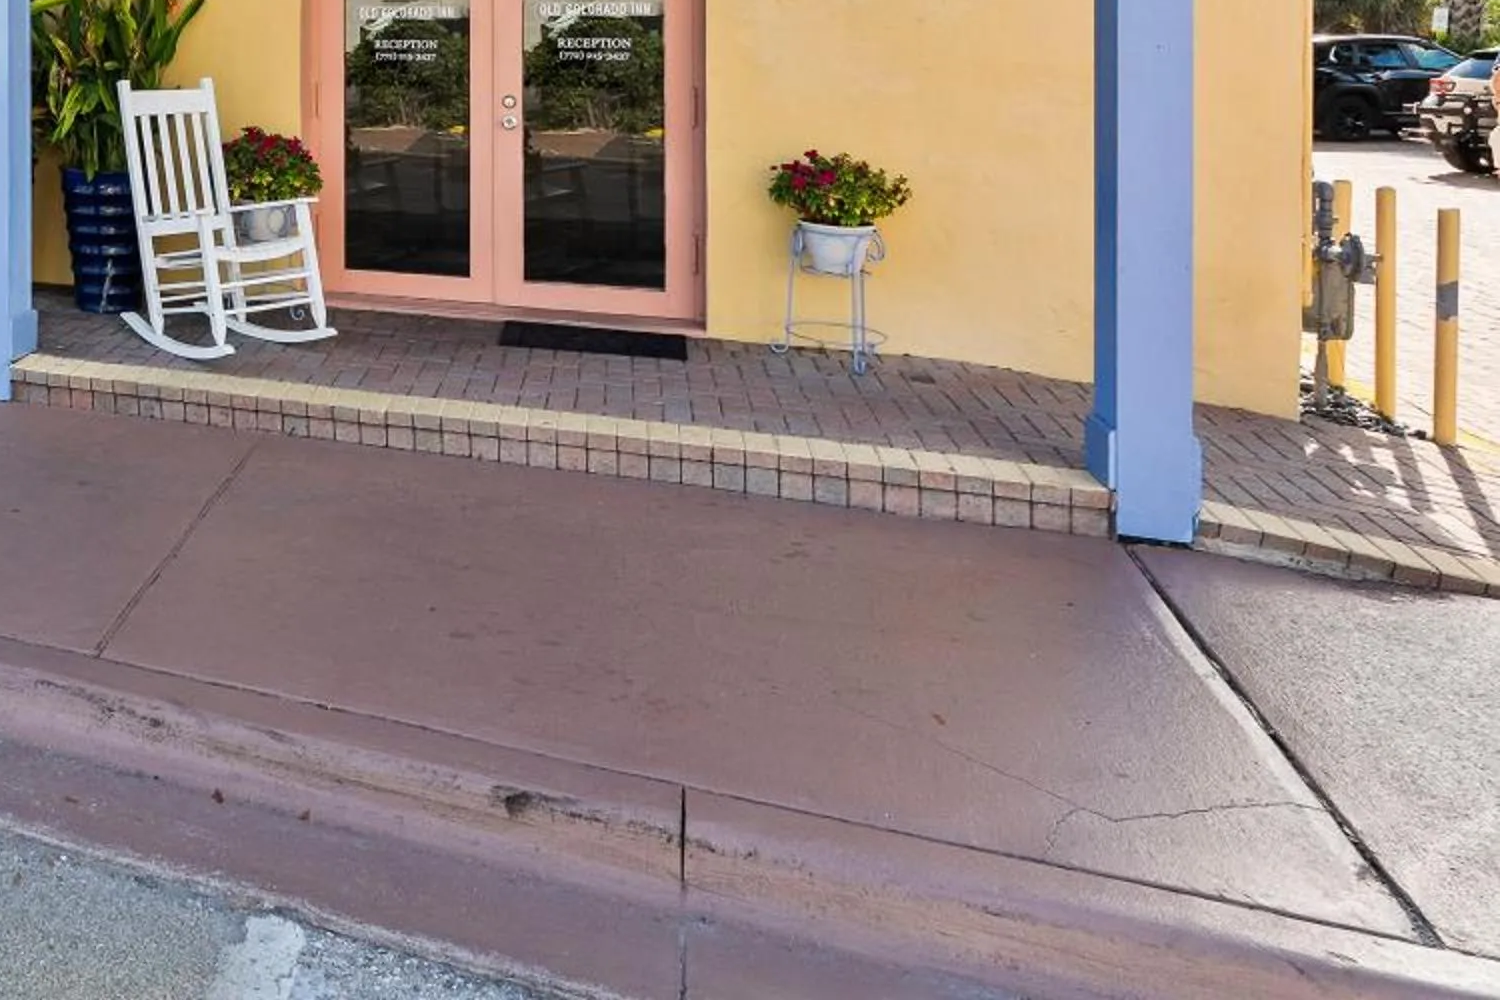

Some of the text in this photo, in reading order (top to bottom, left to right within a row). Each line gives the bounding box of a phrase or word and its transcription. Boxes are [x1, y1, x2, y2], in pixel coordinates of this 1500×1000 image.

[539, 3, 561, 16] OLD
[630, 2, 651, 16] INN
[374, 39, 439, 49] RECEPTION
[556, 37, 632, 49] RECEPTION
